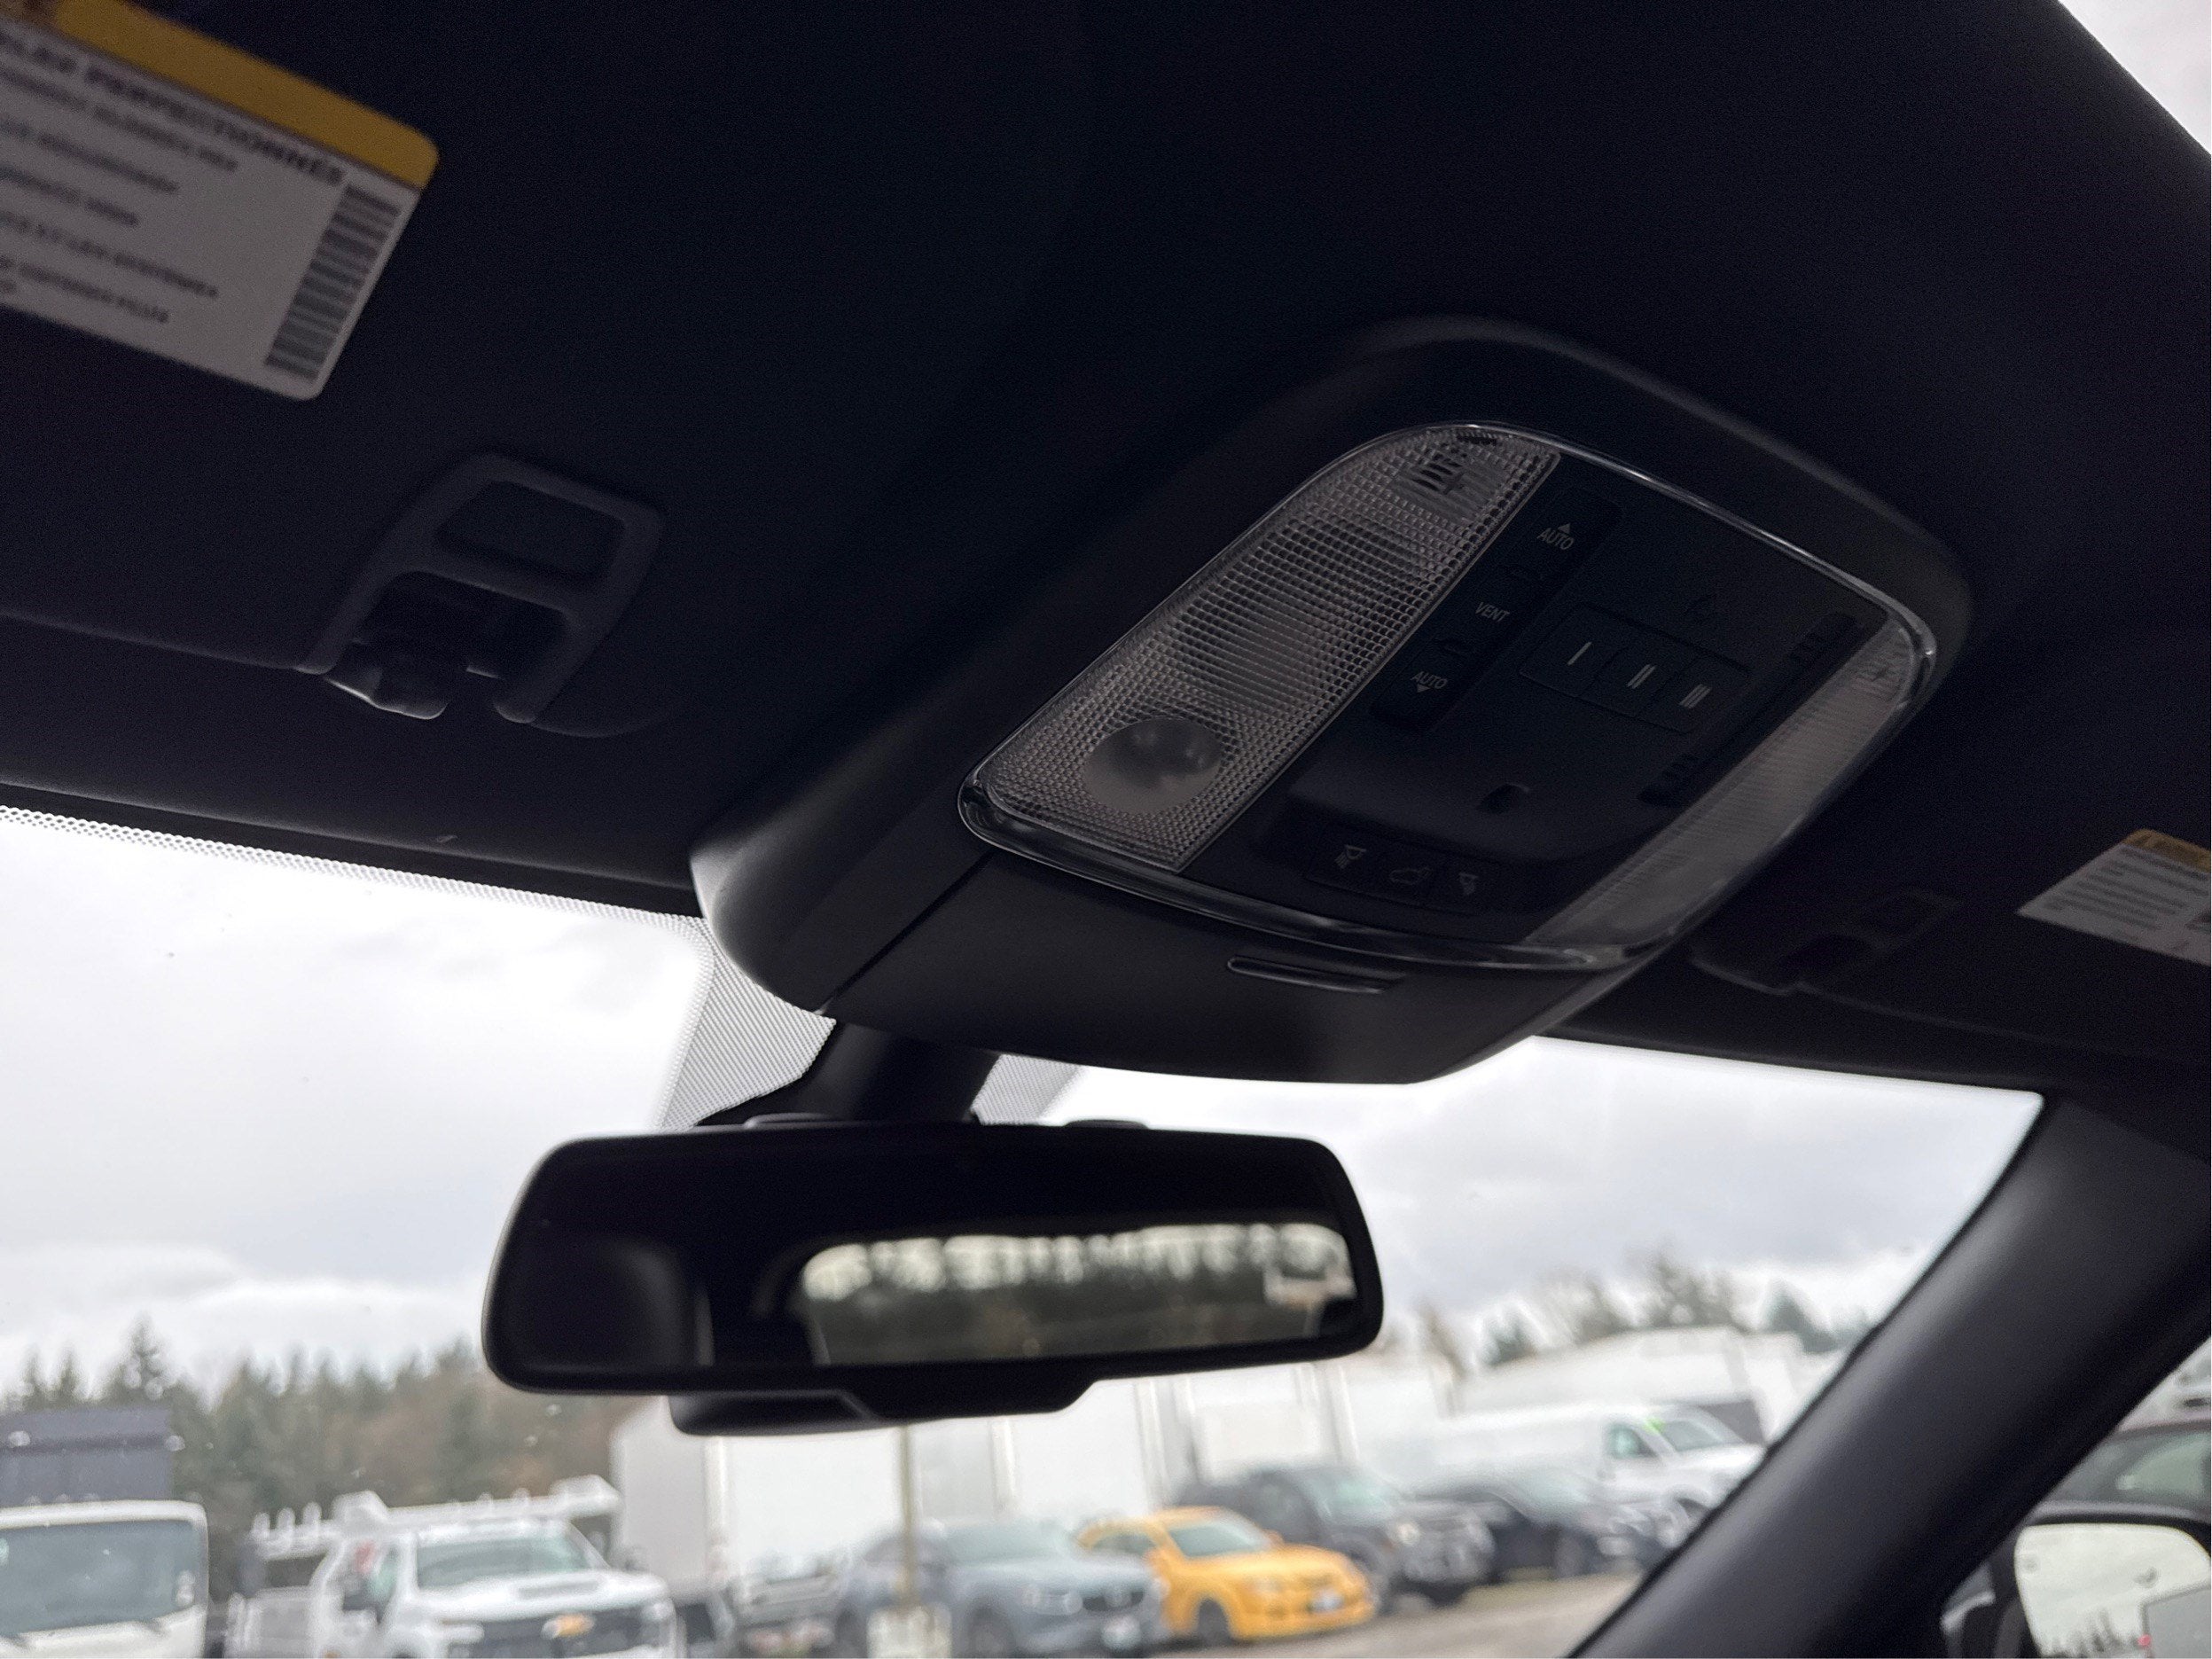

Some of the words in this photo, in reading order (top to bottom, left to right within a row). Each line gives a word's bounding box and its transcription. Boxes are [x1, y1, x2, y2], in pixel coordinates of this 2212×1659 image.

[1536, 527, 1575, 552] AUTO
[1474, 601, 1511, 622] VENT
[1411, 671, 1449, 691] AUTO
